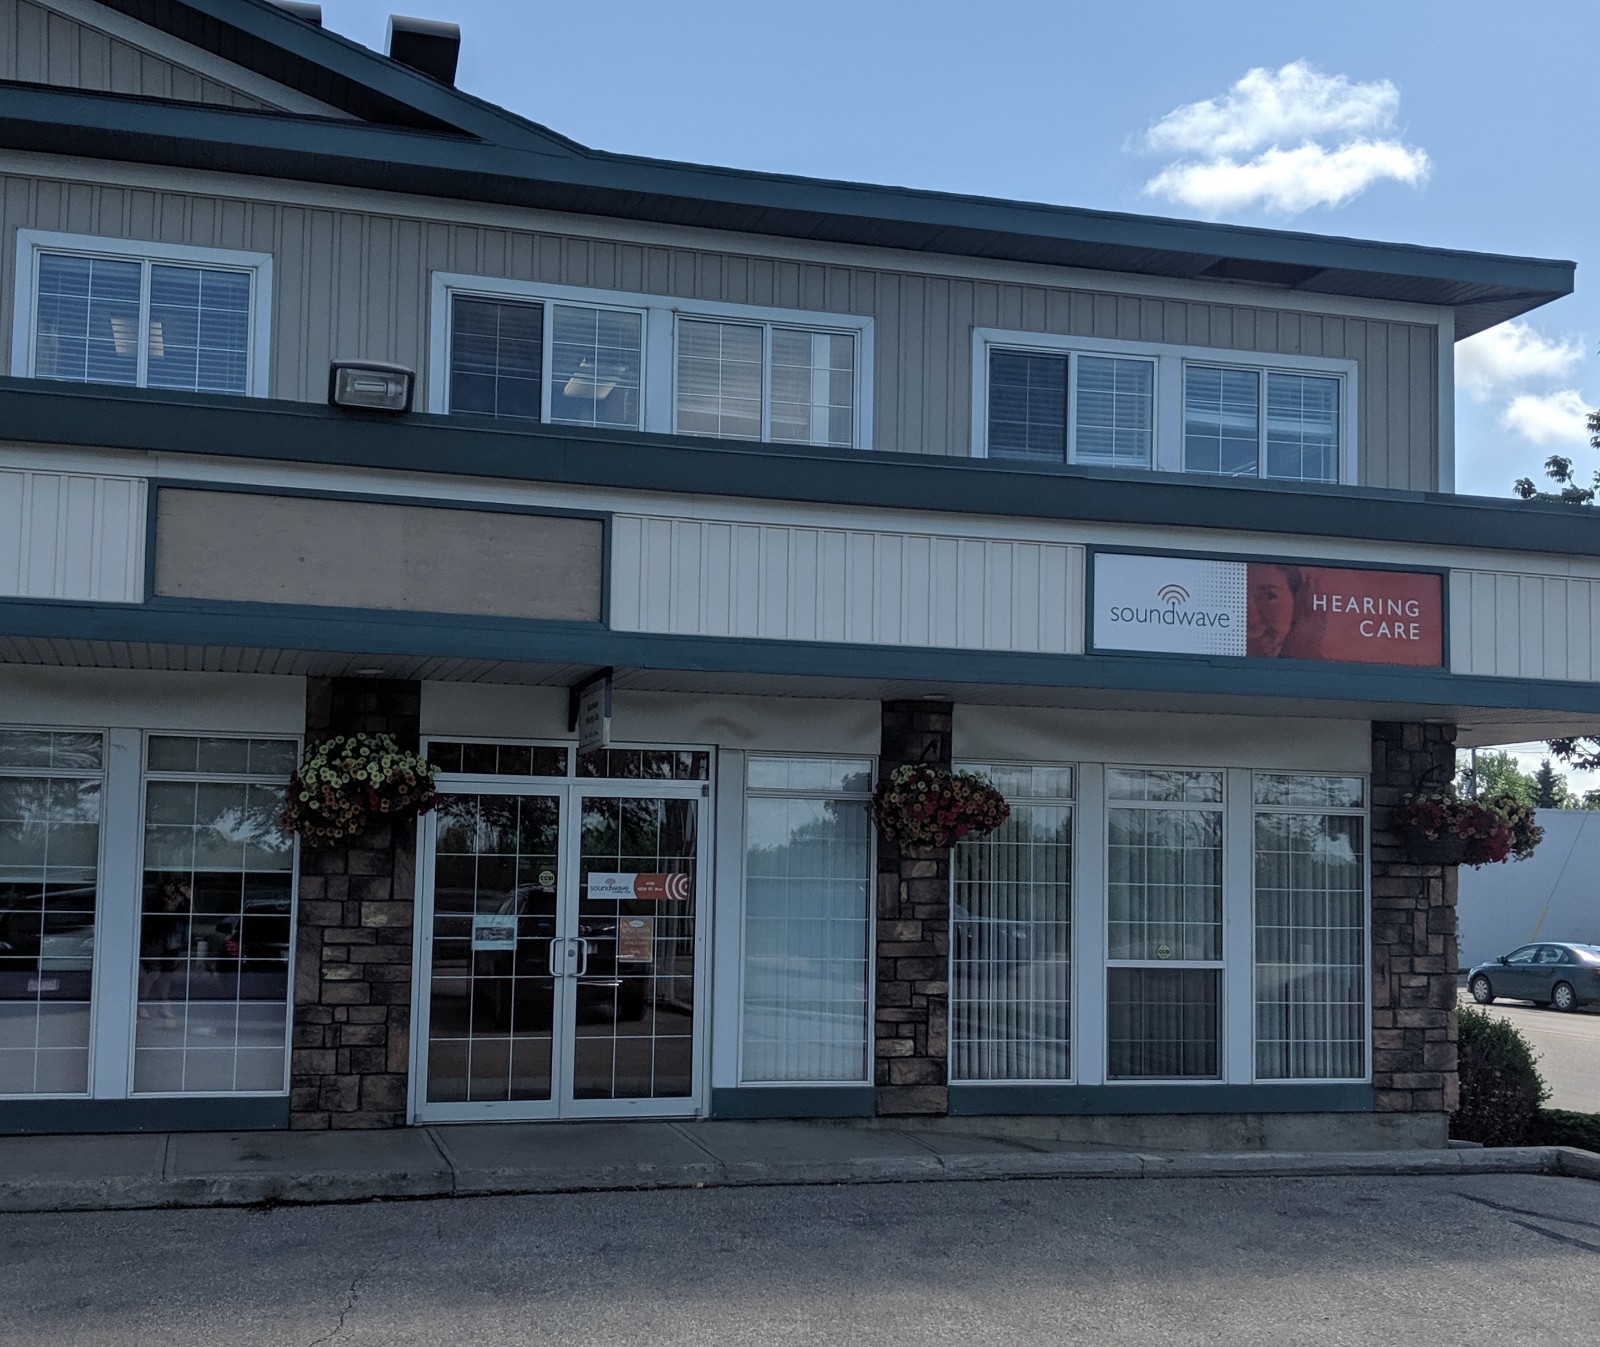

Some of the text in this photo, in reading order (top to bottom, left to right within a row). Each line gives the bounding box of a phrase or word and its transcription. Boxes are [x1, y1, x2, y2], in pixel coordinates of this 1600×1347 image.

[1110, 600, 1230, 629] soundwave
[1313, 594, 1420, 617] HEARING
[1359, 620, 1420, 640] CARE
[590, 884, 630, 892] soundwave
